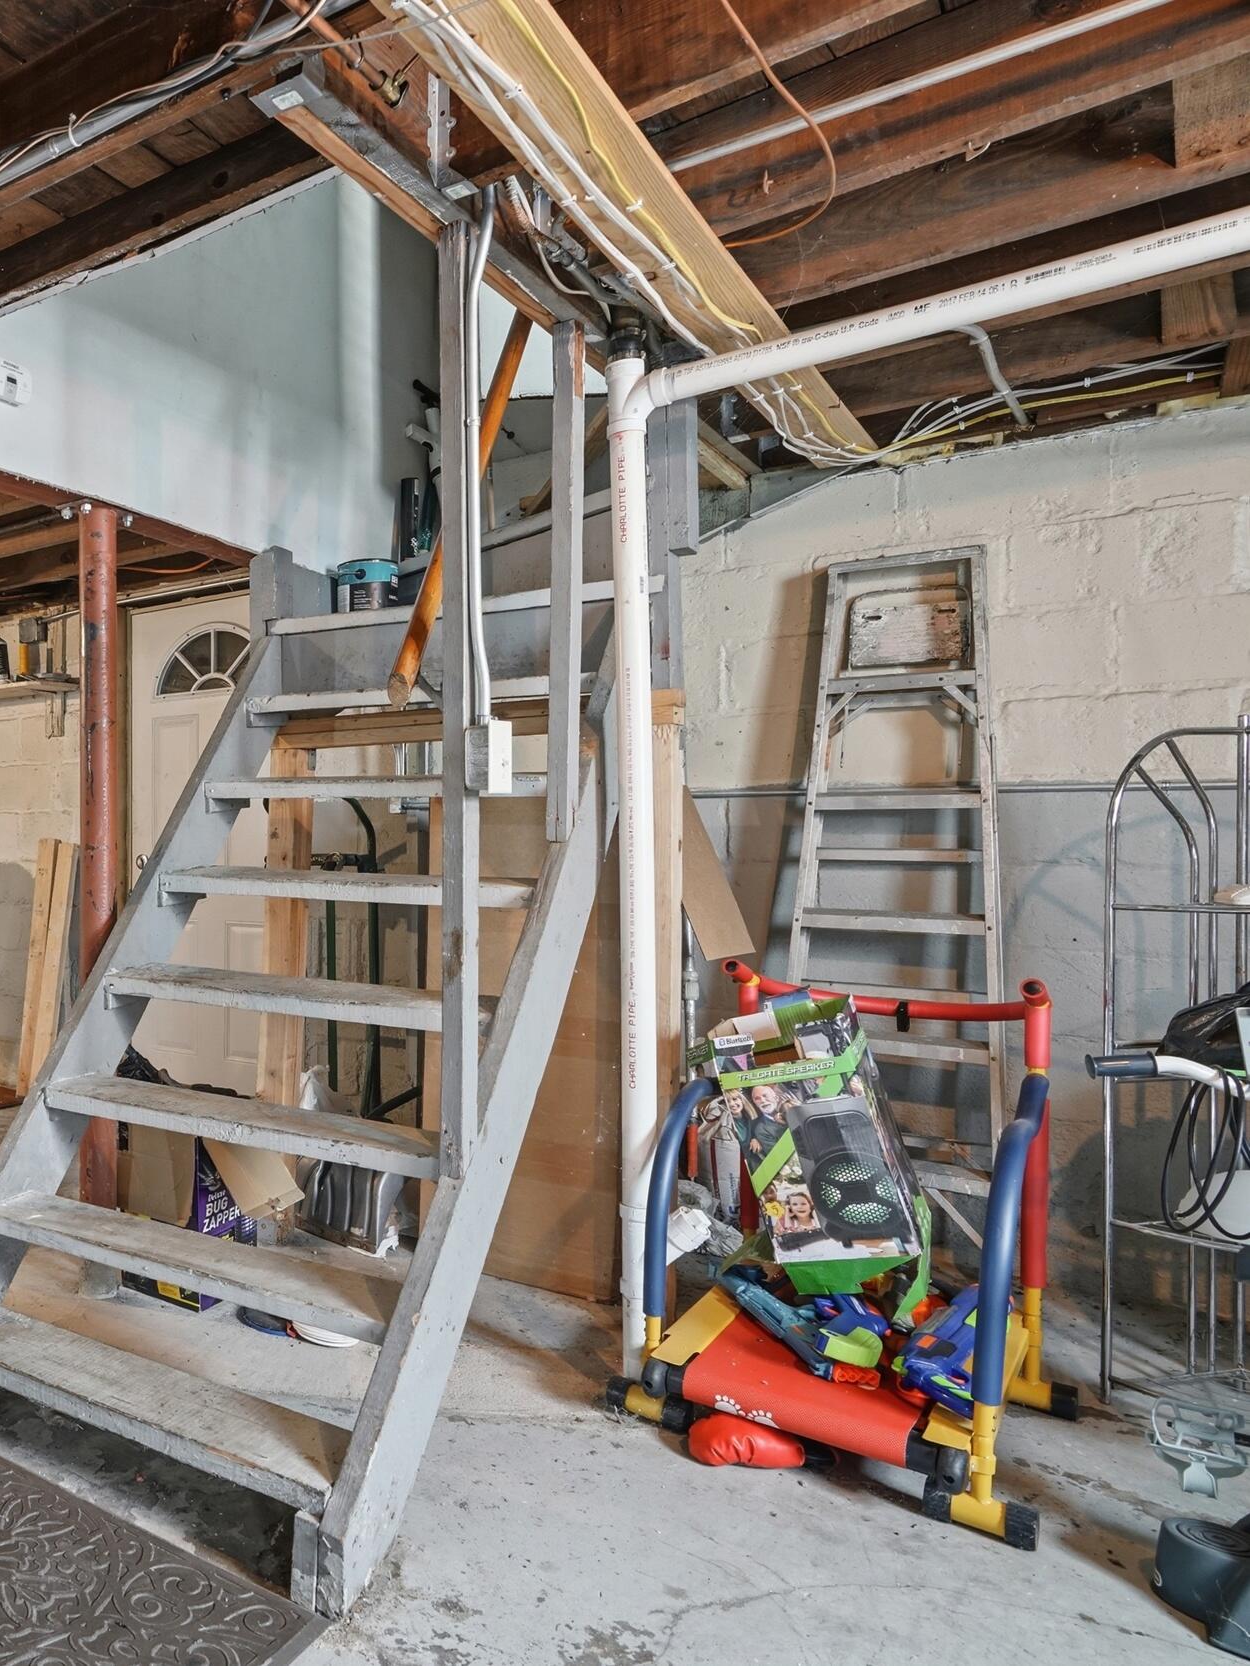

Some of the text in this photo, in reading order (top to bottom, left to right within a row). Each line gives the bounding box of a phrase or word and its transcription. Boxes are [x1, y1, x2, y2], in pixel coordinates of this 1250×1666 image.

[858, 318, 879, 329] Code
[617, 455, 628, 543] CHARLOTTE PIPE
[628, 1000, 637, 1089] CHARLOTTE PIPE
[739, 1060, 836, 1082] TAILGATE SPEAKER
[202, 1205, 241, 1234] ZAPPER
[205, 1196, 229, 1218] BUG
